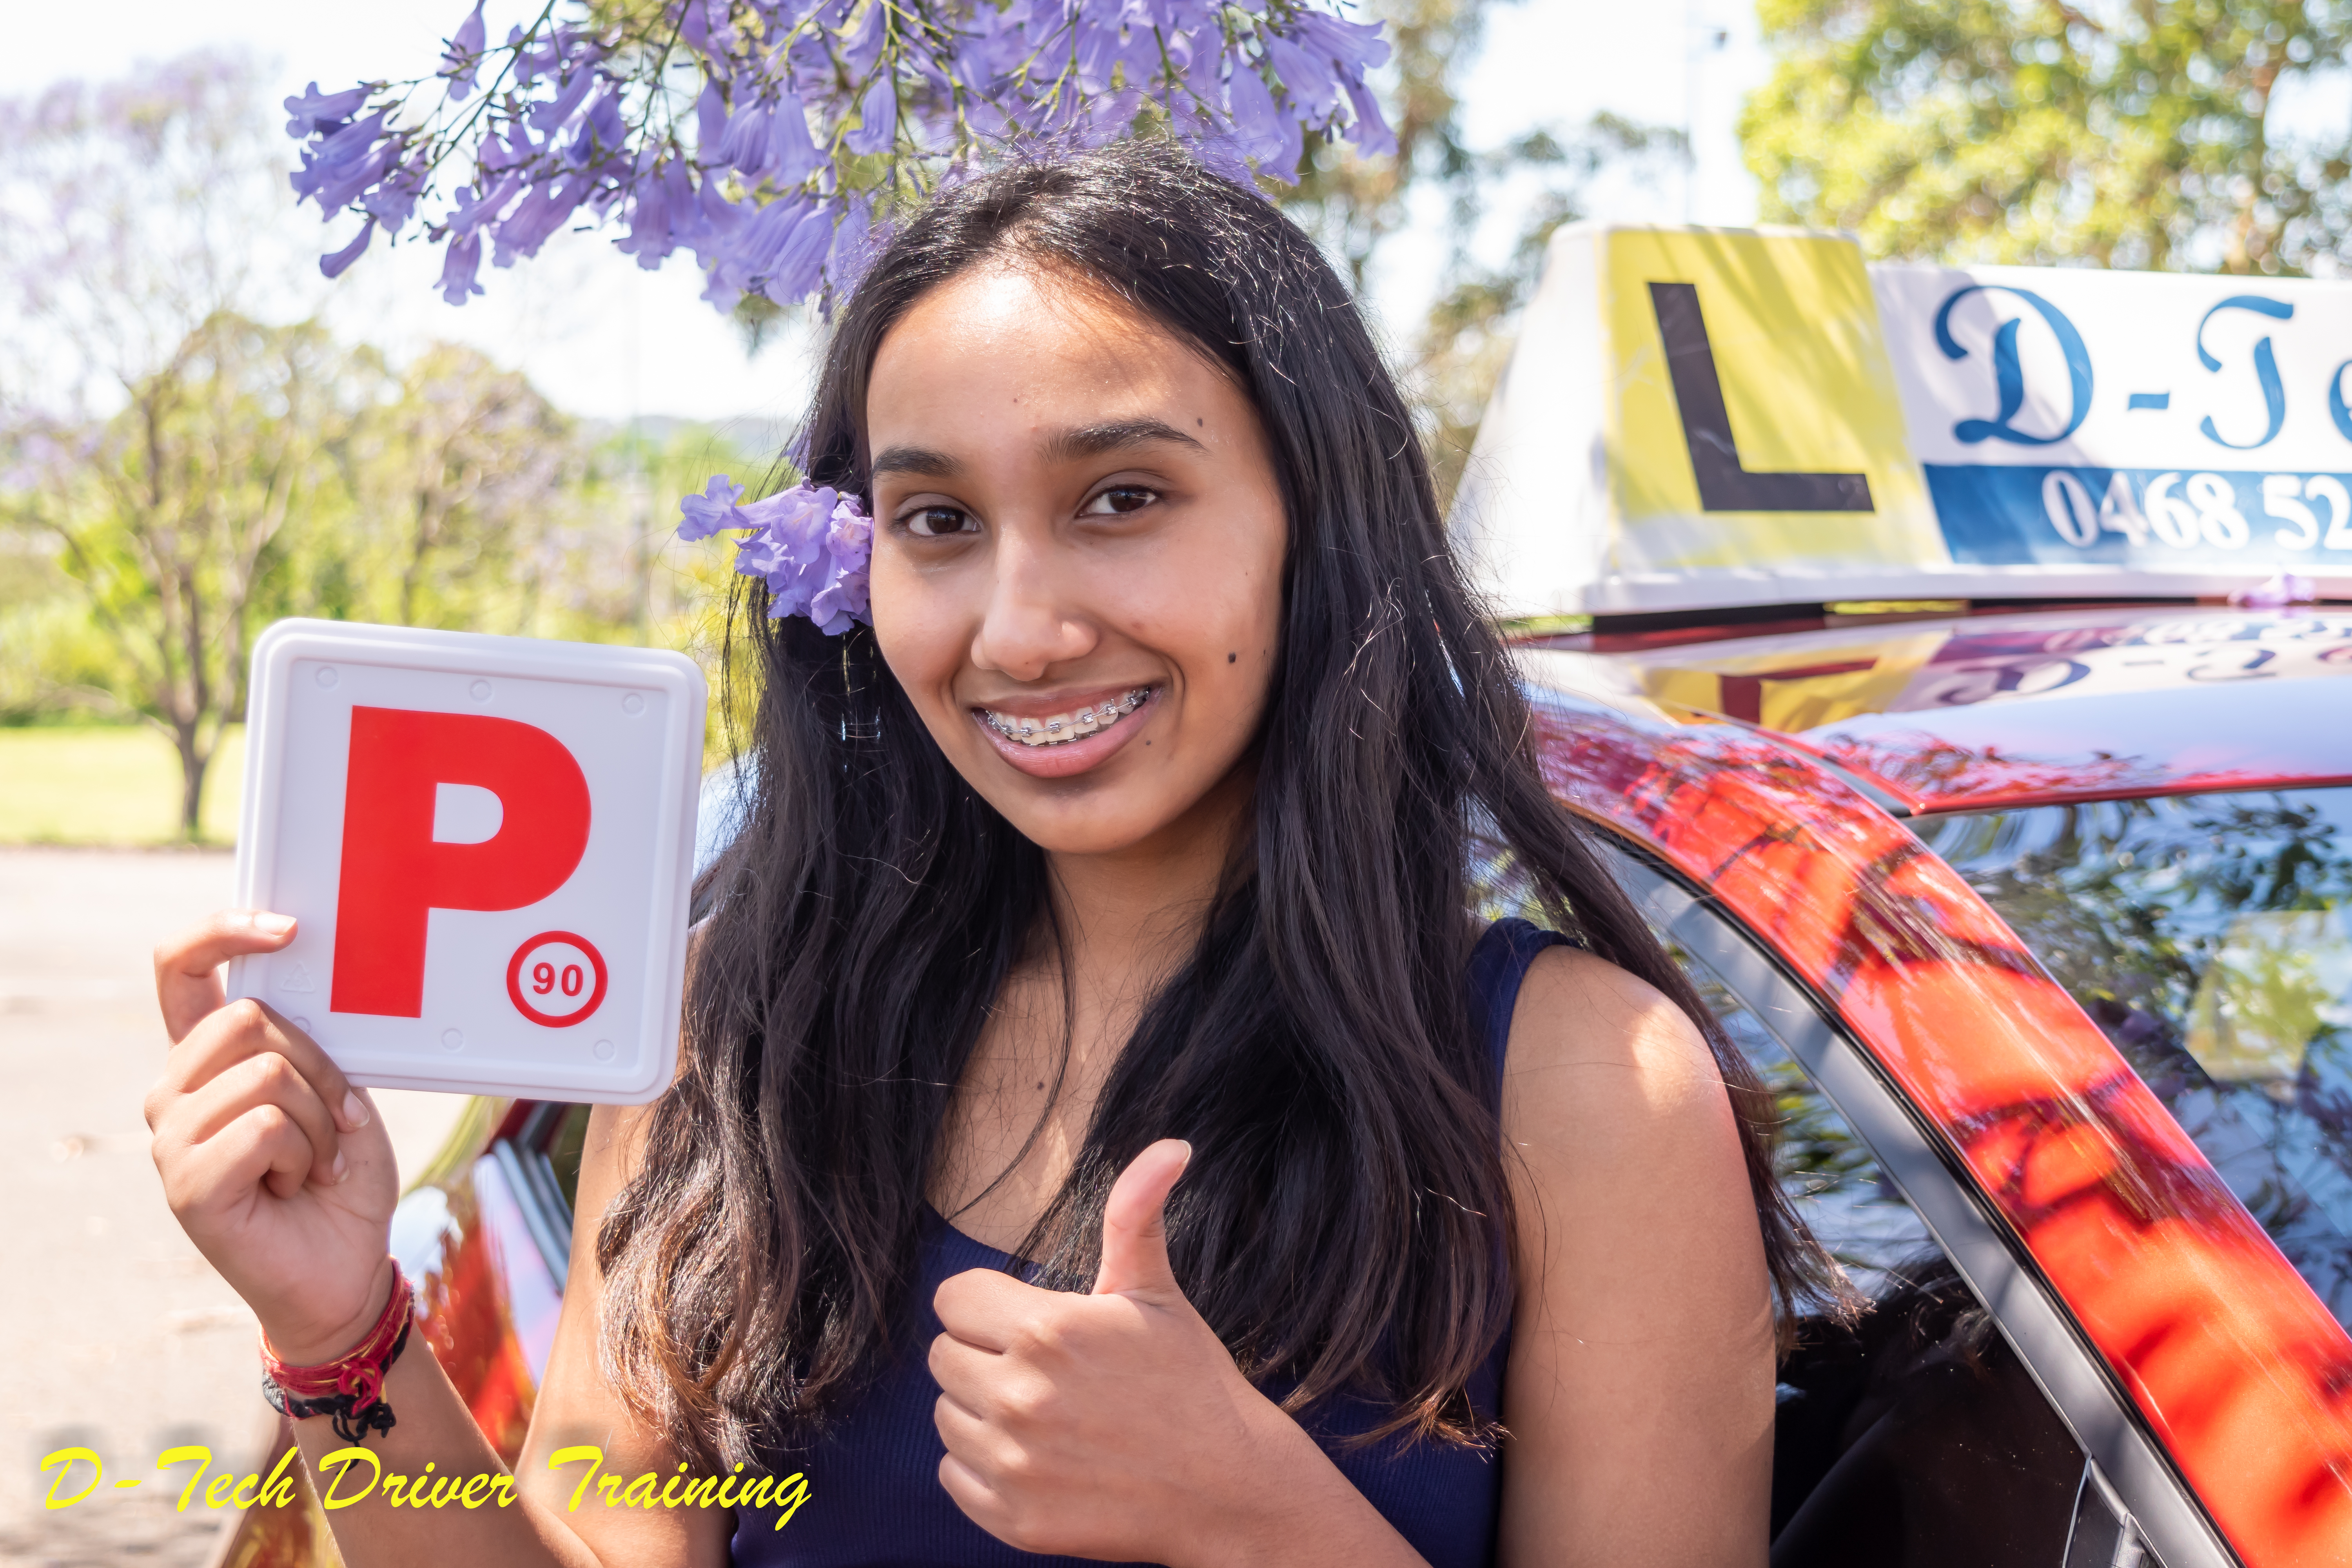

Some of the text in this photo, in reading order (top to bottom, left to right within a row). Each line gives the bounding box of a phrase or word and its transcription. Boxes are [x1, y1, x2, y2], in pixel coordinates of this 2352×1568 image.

[1647, 282, 1875, 512] L
[2041, 470, 2352, 550] 0468 52
[330, 704, 592, 1019] P
[532, 962, 584, 997] 90
